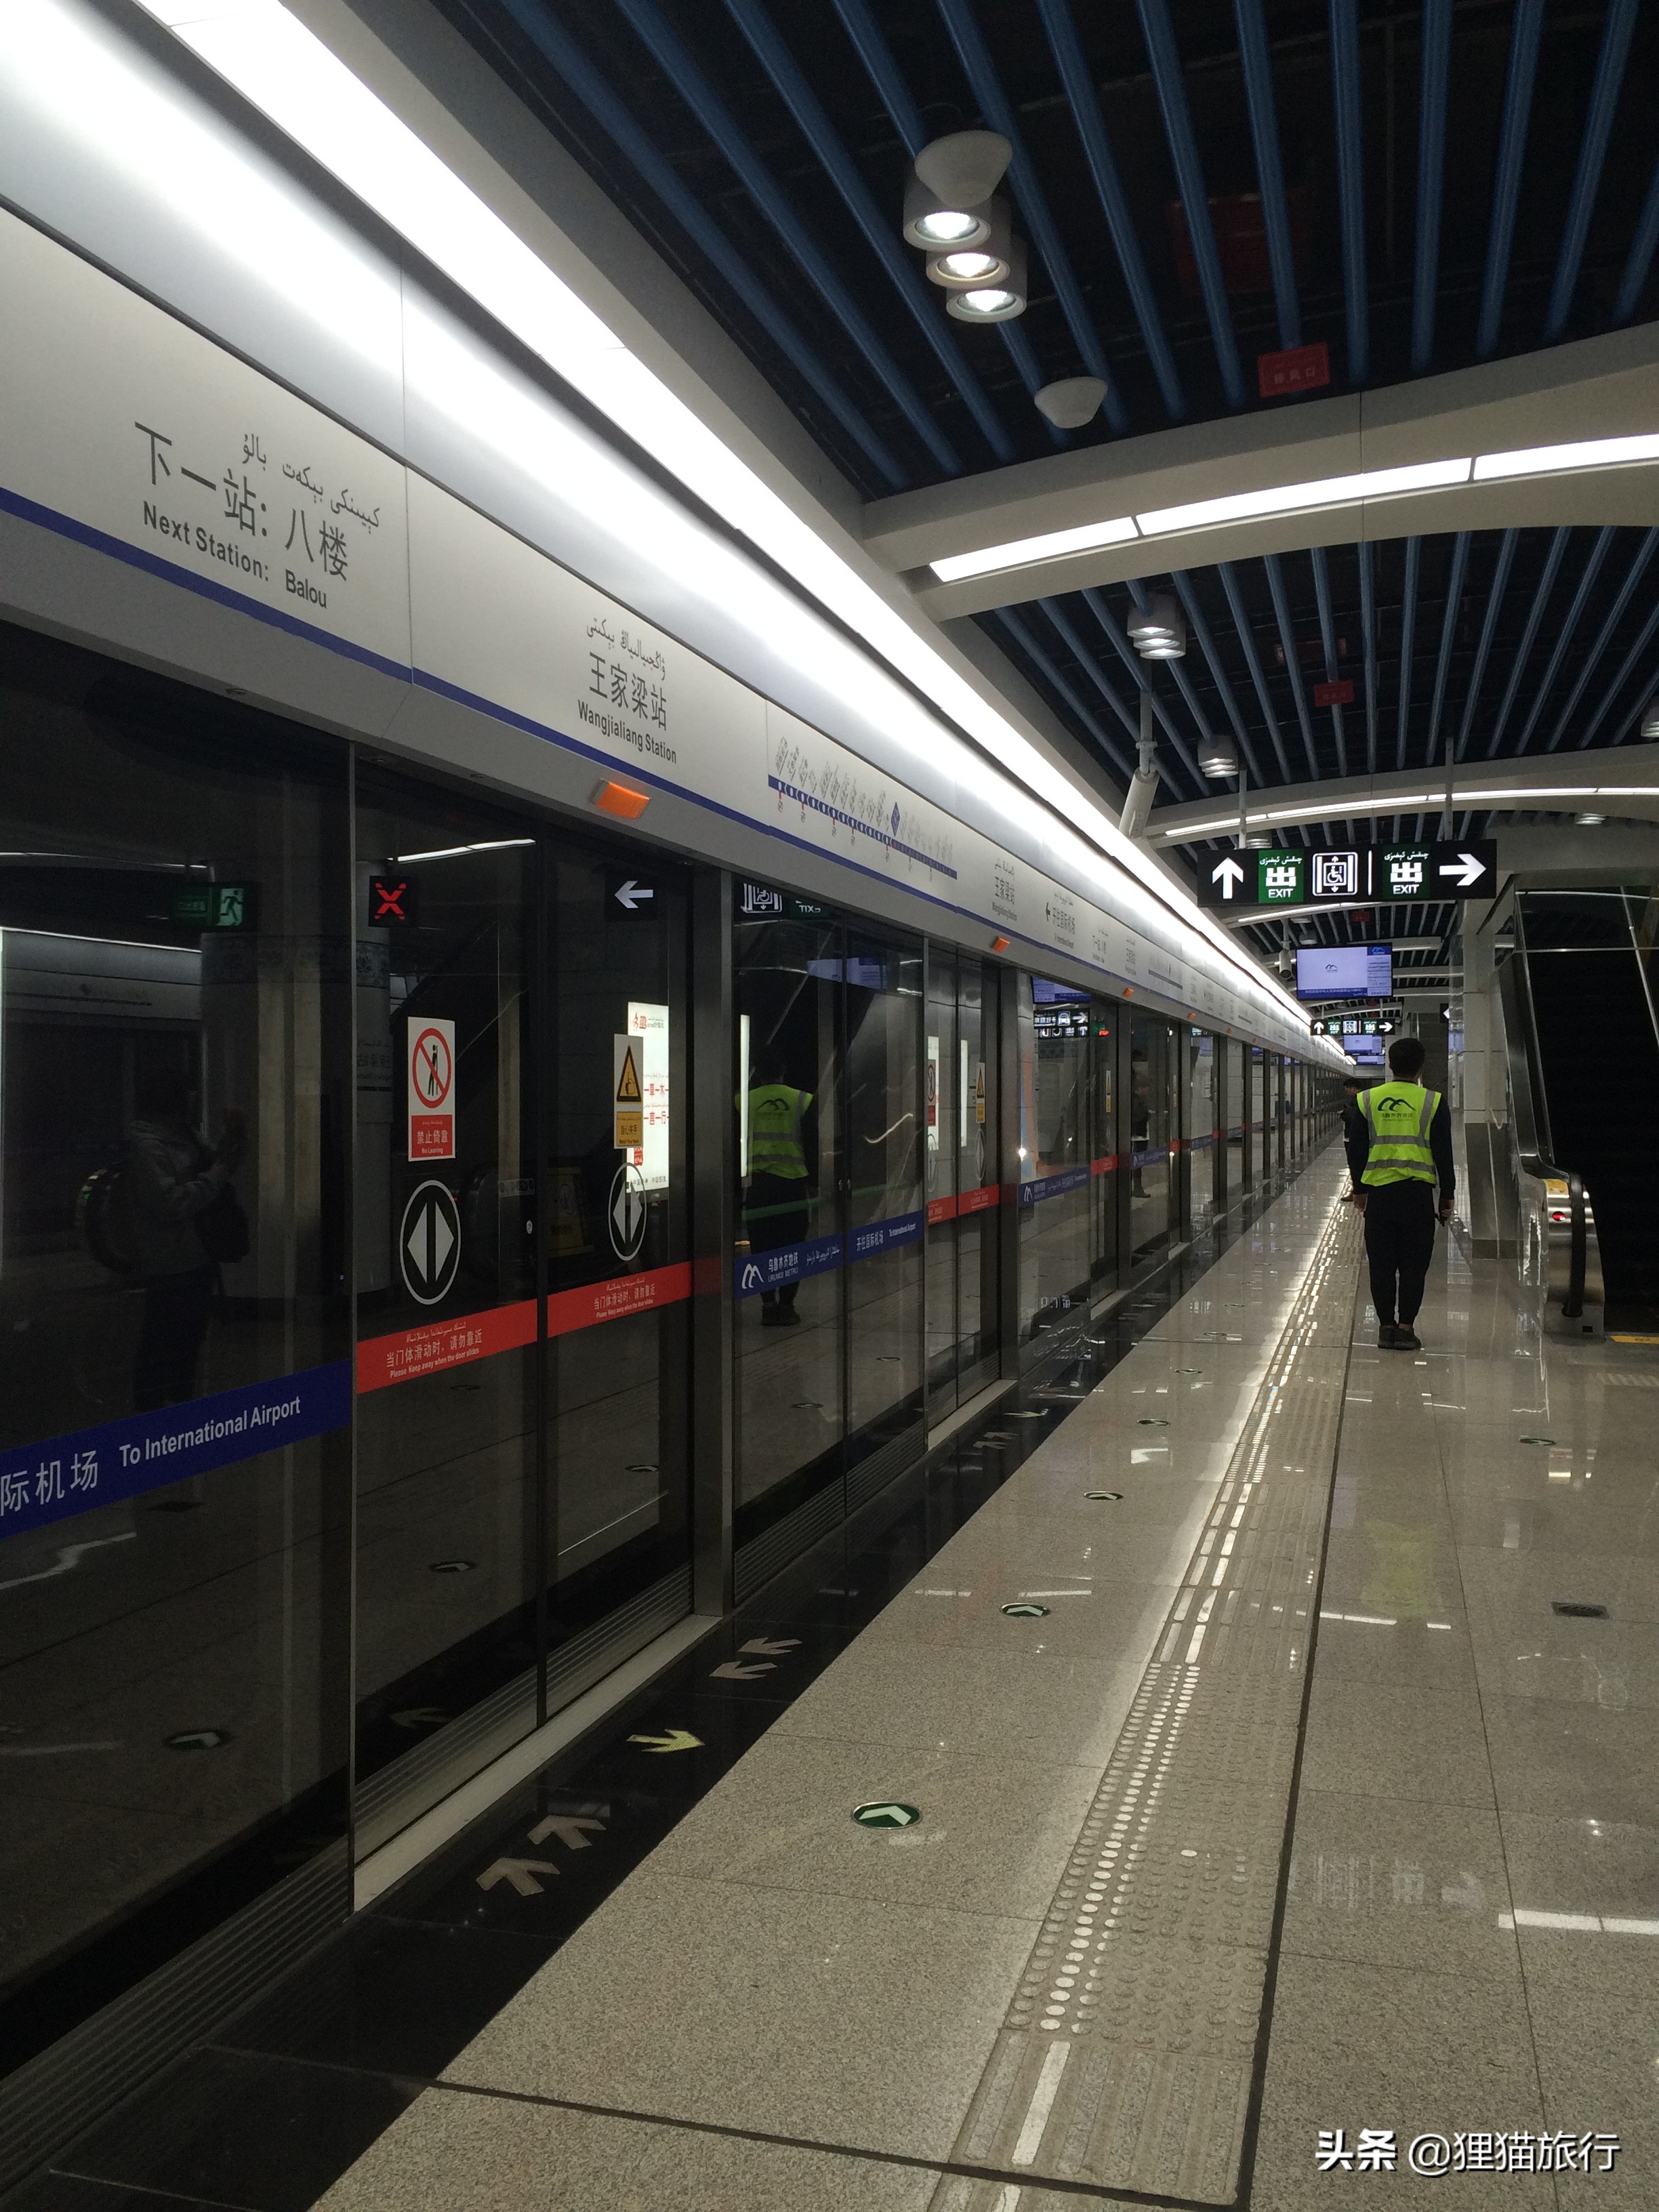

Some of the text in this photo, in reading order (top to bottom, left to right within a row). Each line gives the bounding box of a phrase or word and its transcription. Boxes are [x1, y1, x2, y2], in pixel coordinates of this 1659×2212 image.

[143, 500, 327, 609] Next Station: Balou
[588, 651, 668, 731] 王家梁站
[577, 699, 677, 764] Wangjialiang Station
[1268, 888, 1294, 898] EXIT
[1393, 884, 1420, 895] EXIT
[417, 1129, 449, 1145] 禁止倚靠
[428, 1147, 444, 1155] Leaning
[386, 1328, 483, 1368] 当门体滑动时，请勿靠近
[390, 1347, 480, 1378] Please Keep away when the door slides
[119, 1395, 301, 1468] To International Airport
[0, 1450, 99, 1516] 际机场
